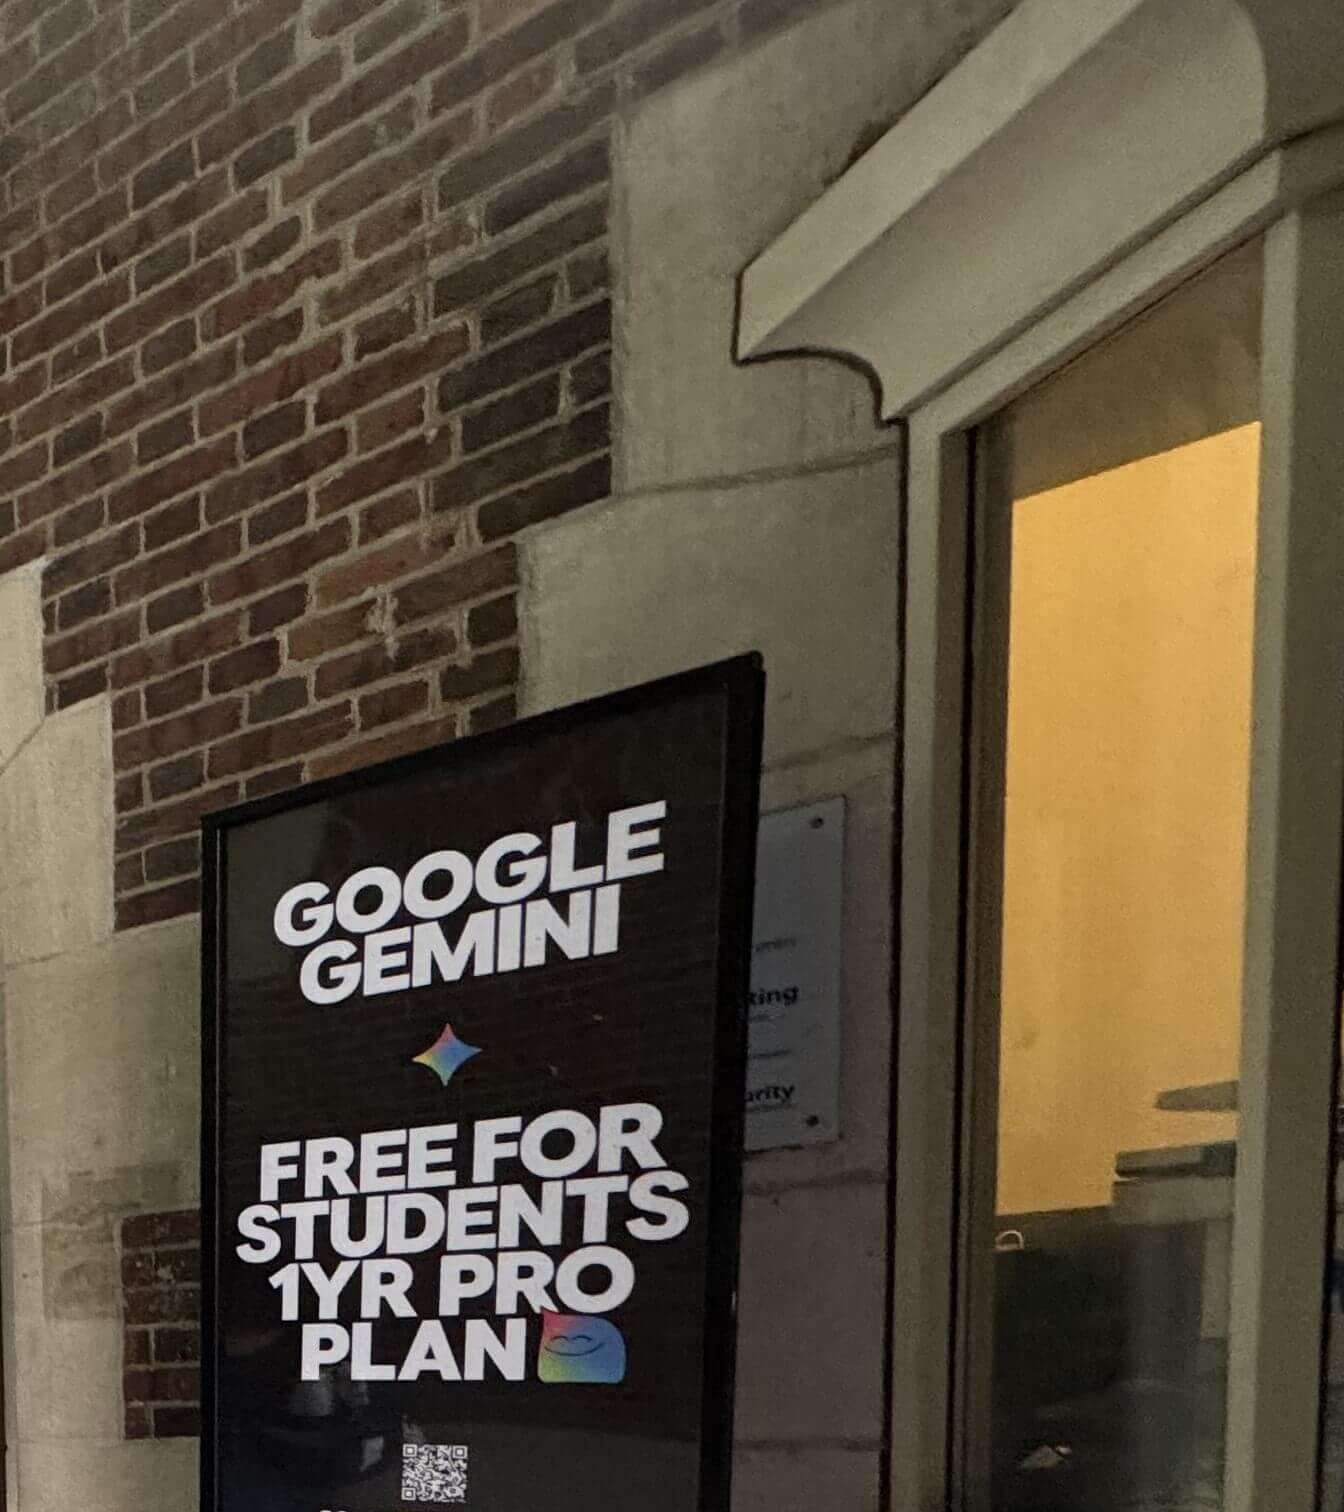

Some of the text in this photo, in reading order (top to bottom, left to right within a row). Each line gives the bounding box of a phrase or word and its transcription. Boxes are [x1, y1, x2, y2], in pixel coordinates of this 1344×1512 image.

[274, 800, 666, 947] GOOGLE
[300, 884, 620, 1005] GEMINI
[260, 1102, 667, 1201] FREE FOR
[236, 1171, 690, 1264] STUDENTS
[268, 1245, 635, 1321] 1YR PRO
[301, 1318, 526, 1382] PLAN
